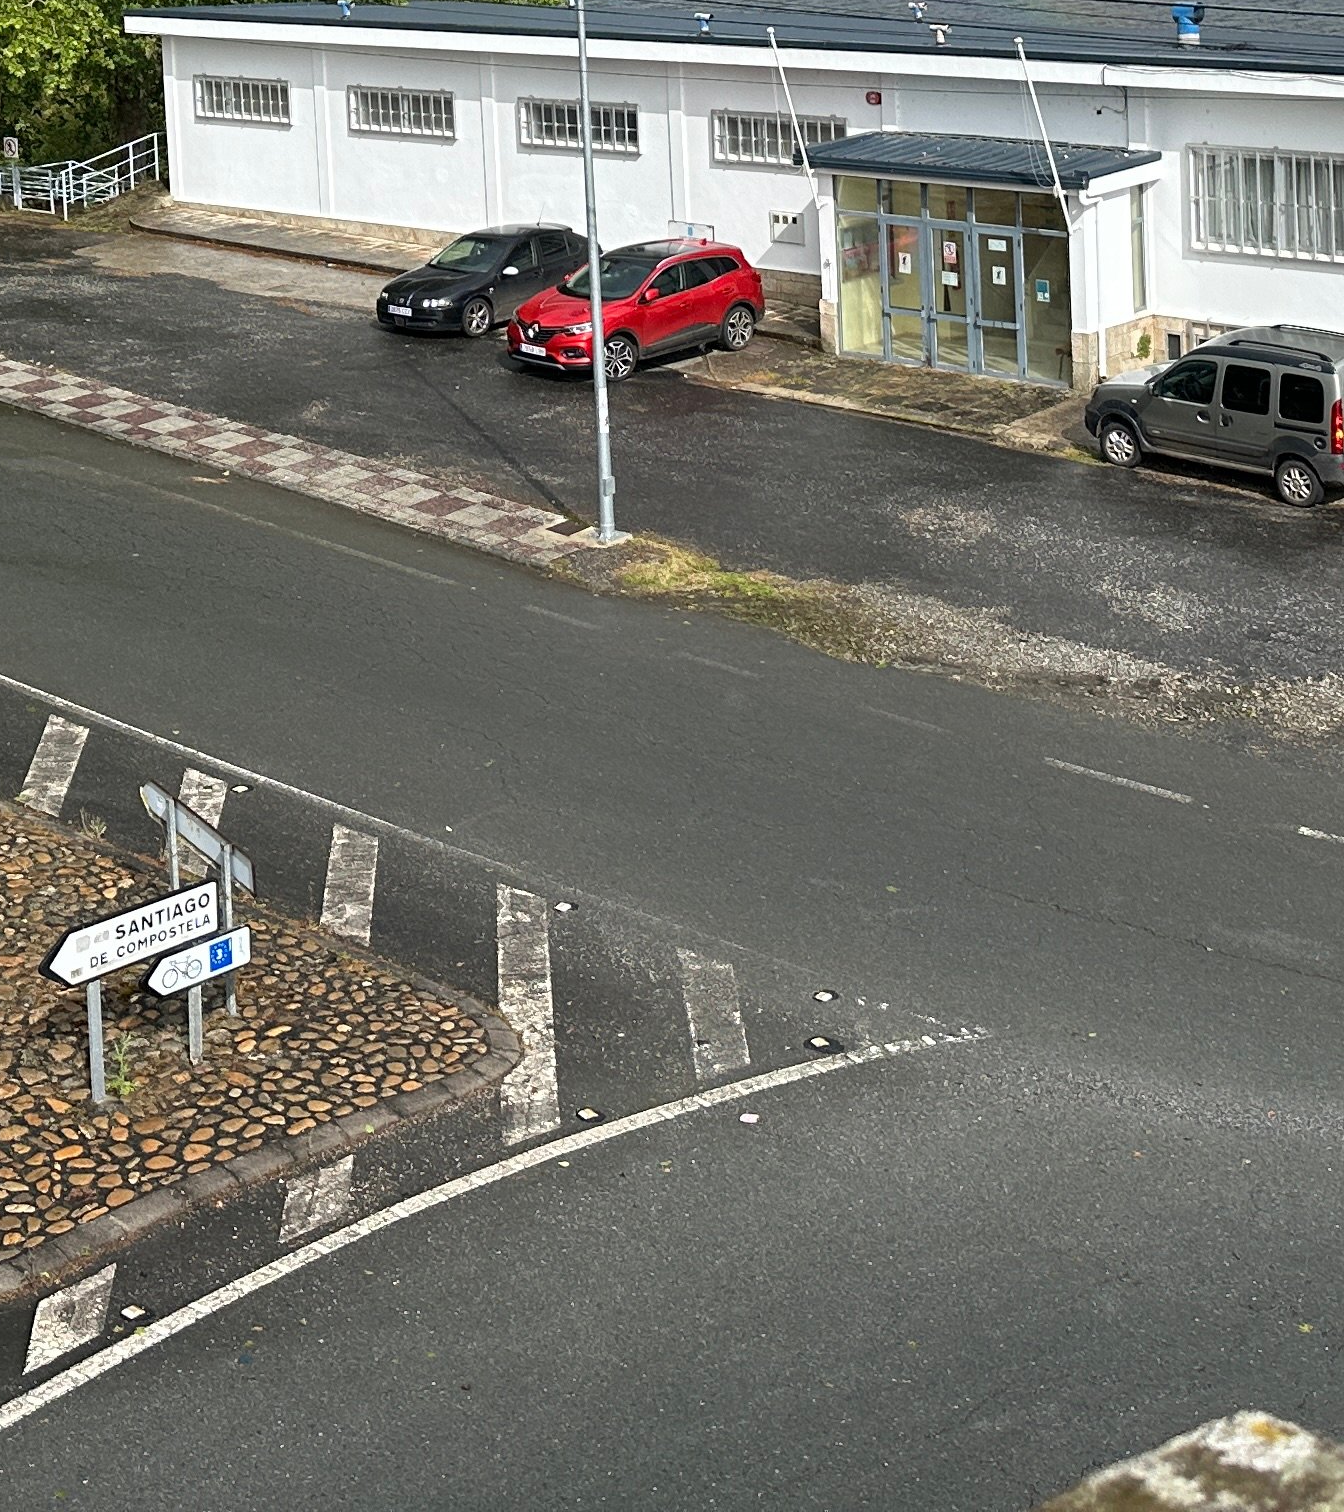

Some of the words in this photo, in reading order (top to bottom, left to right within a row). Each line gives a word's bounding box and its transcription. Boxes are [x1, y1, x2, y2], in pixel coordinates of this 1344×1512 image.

[115, 893, 210, 939] SANTIAGO
[90, 952, 108, 968] DE
[117, 914, 210, 957] COMPOSTELA
[216, 948, 223, 960] 3
